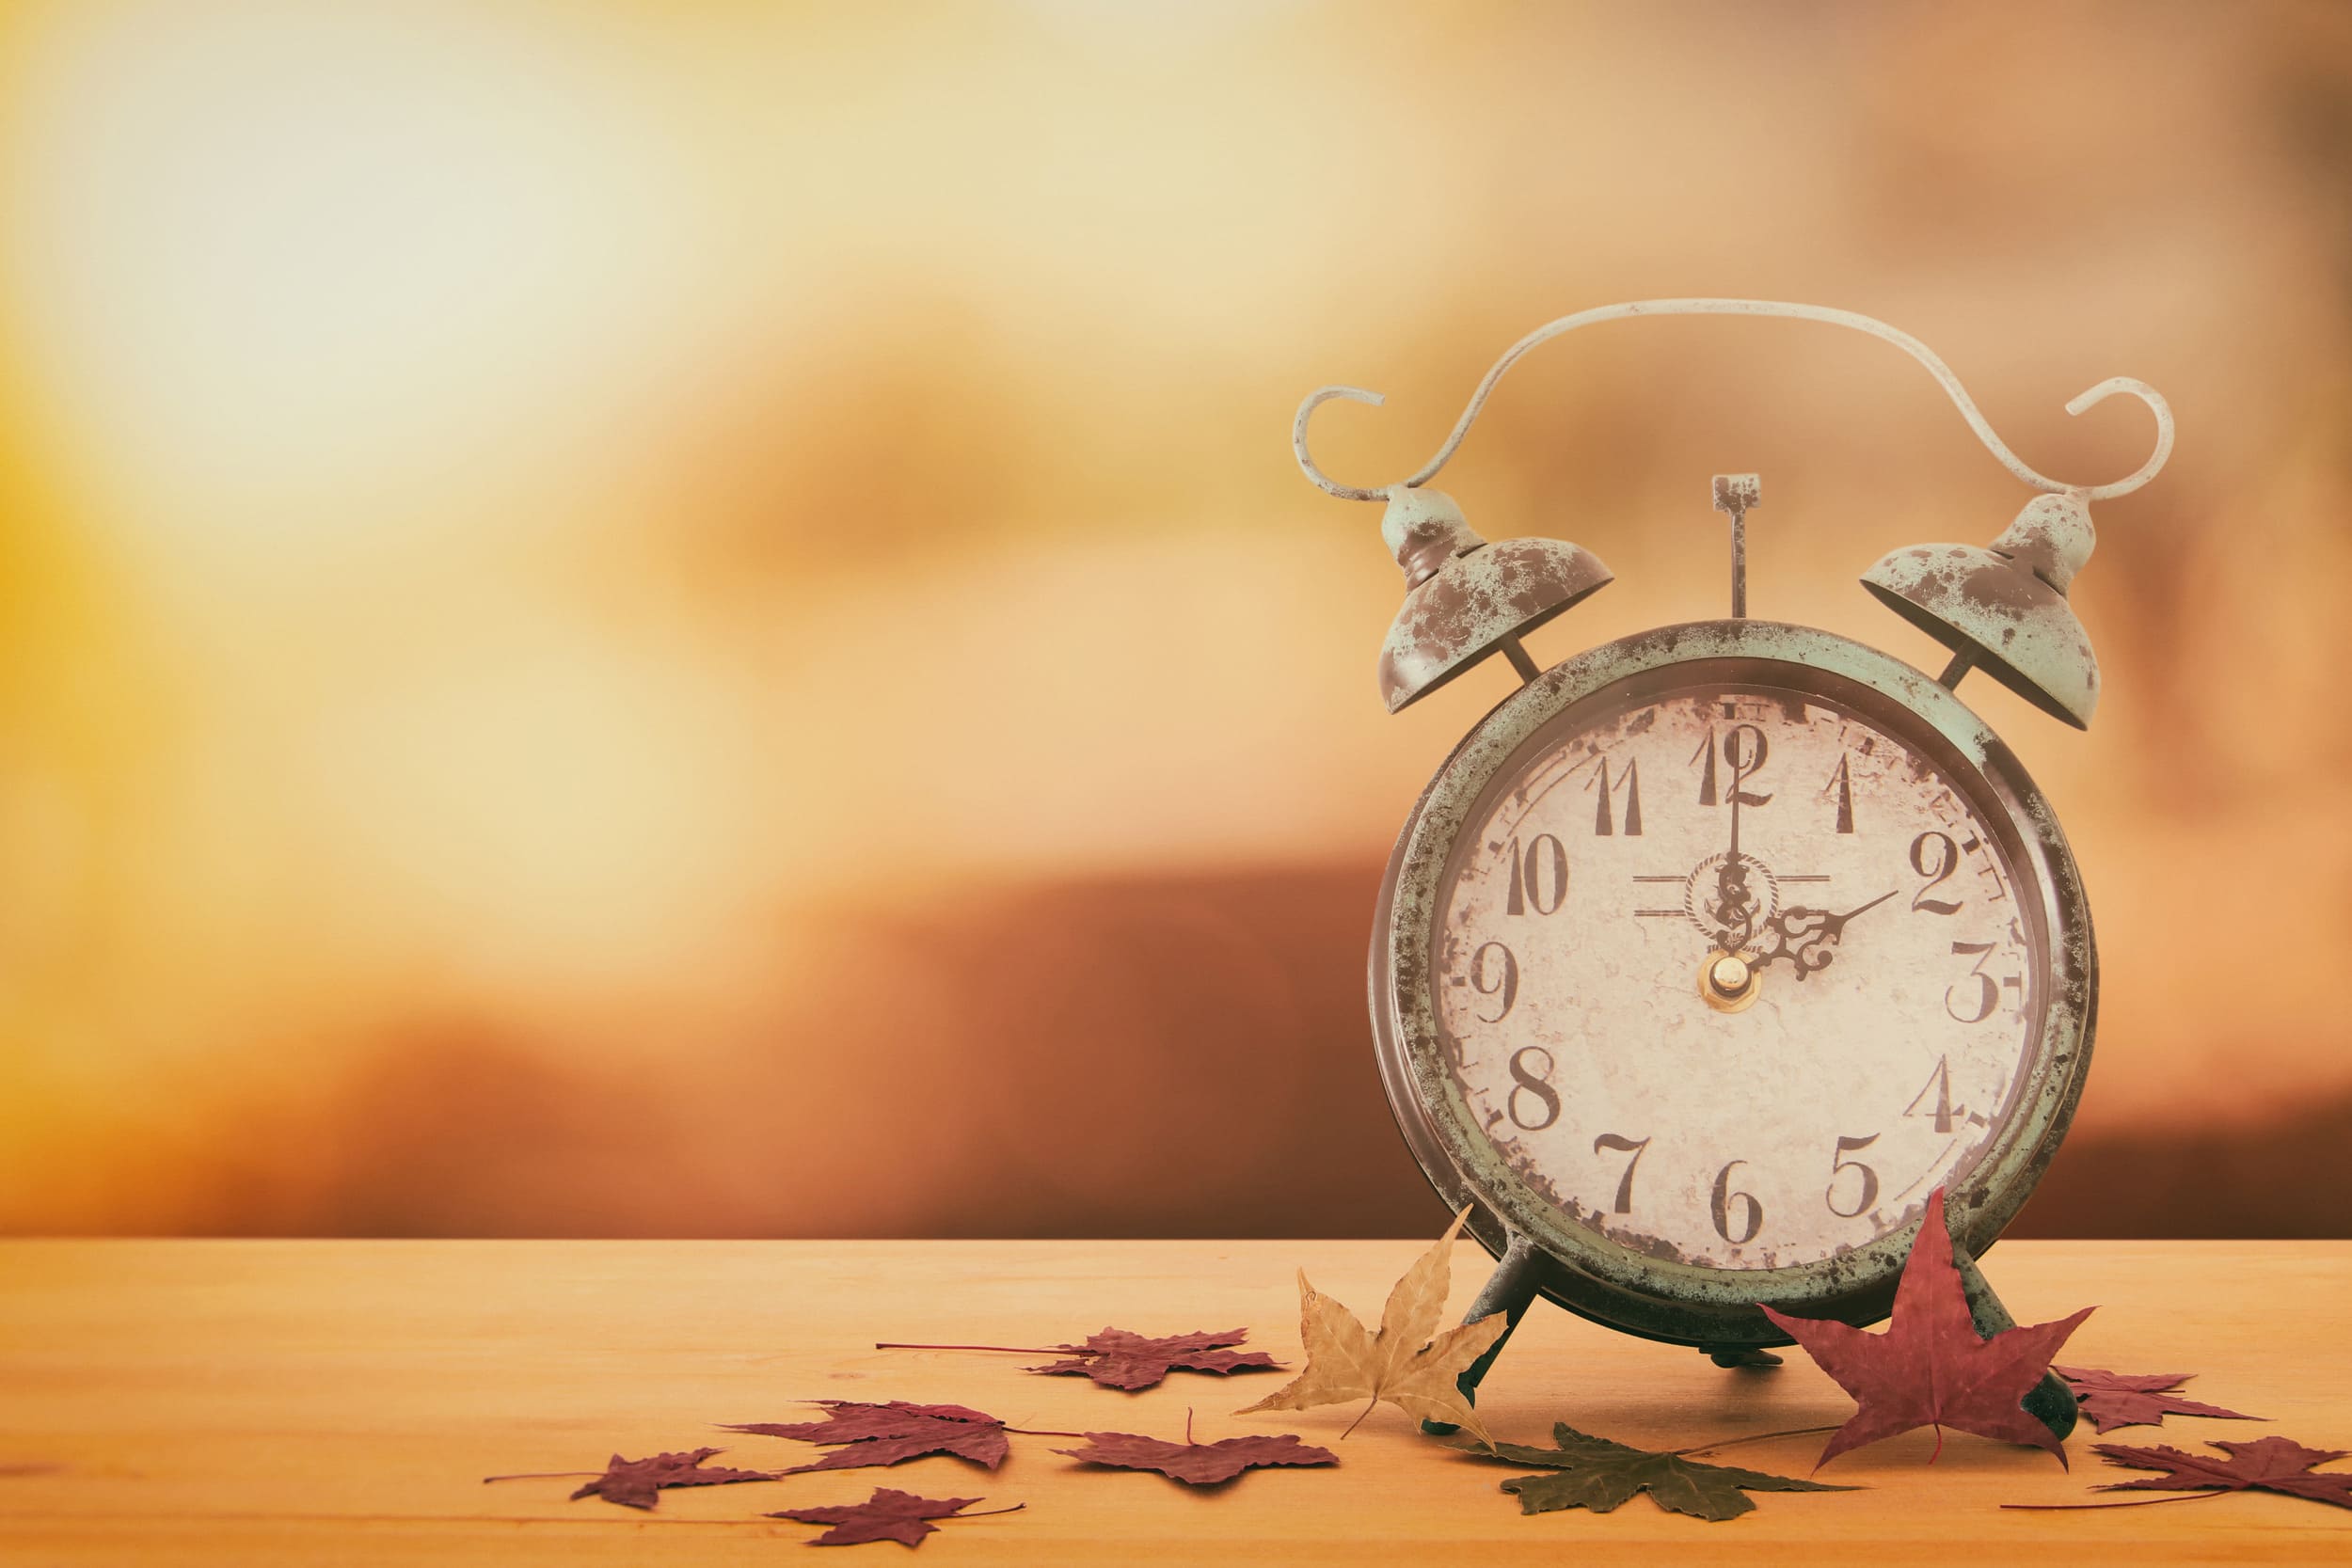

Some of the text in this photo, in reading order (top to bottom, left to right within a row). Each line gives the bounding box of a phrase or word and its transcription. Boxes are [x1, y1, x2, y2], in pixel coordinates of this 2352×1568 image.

[1584, 756, 1643, 836] 11
[1689, 724, 1773, 807] 12
[1823, 752, 1854, 833] 1
[1507, 833, 1568, 915] 10
[1910, 832, 1963, 915] 2
[1470, 942, 1518, 1023] 9
[1945, 942, 1999, 1023] 3
[1508, 1046, 1561, 1131] 8
[1903, 1053, 1965, 1133] 4
[1594, 1133, 1651, 1213] 7
[1710, 1160, 1763, 1244] 6
[1826, 1132, 1881, 1218] 5
